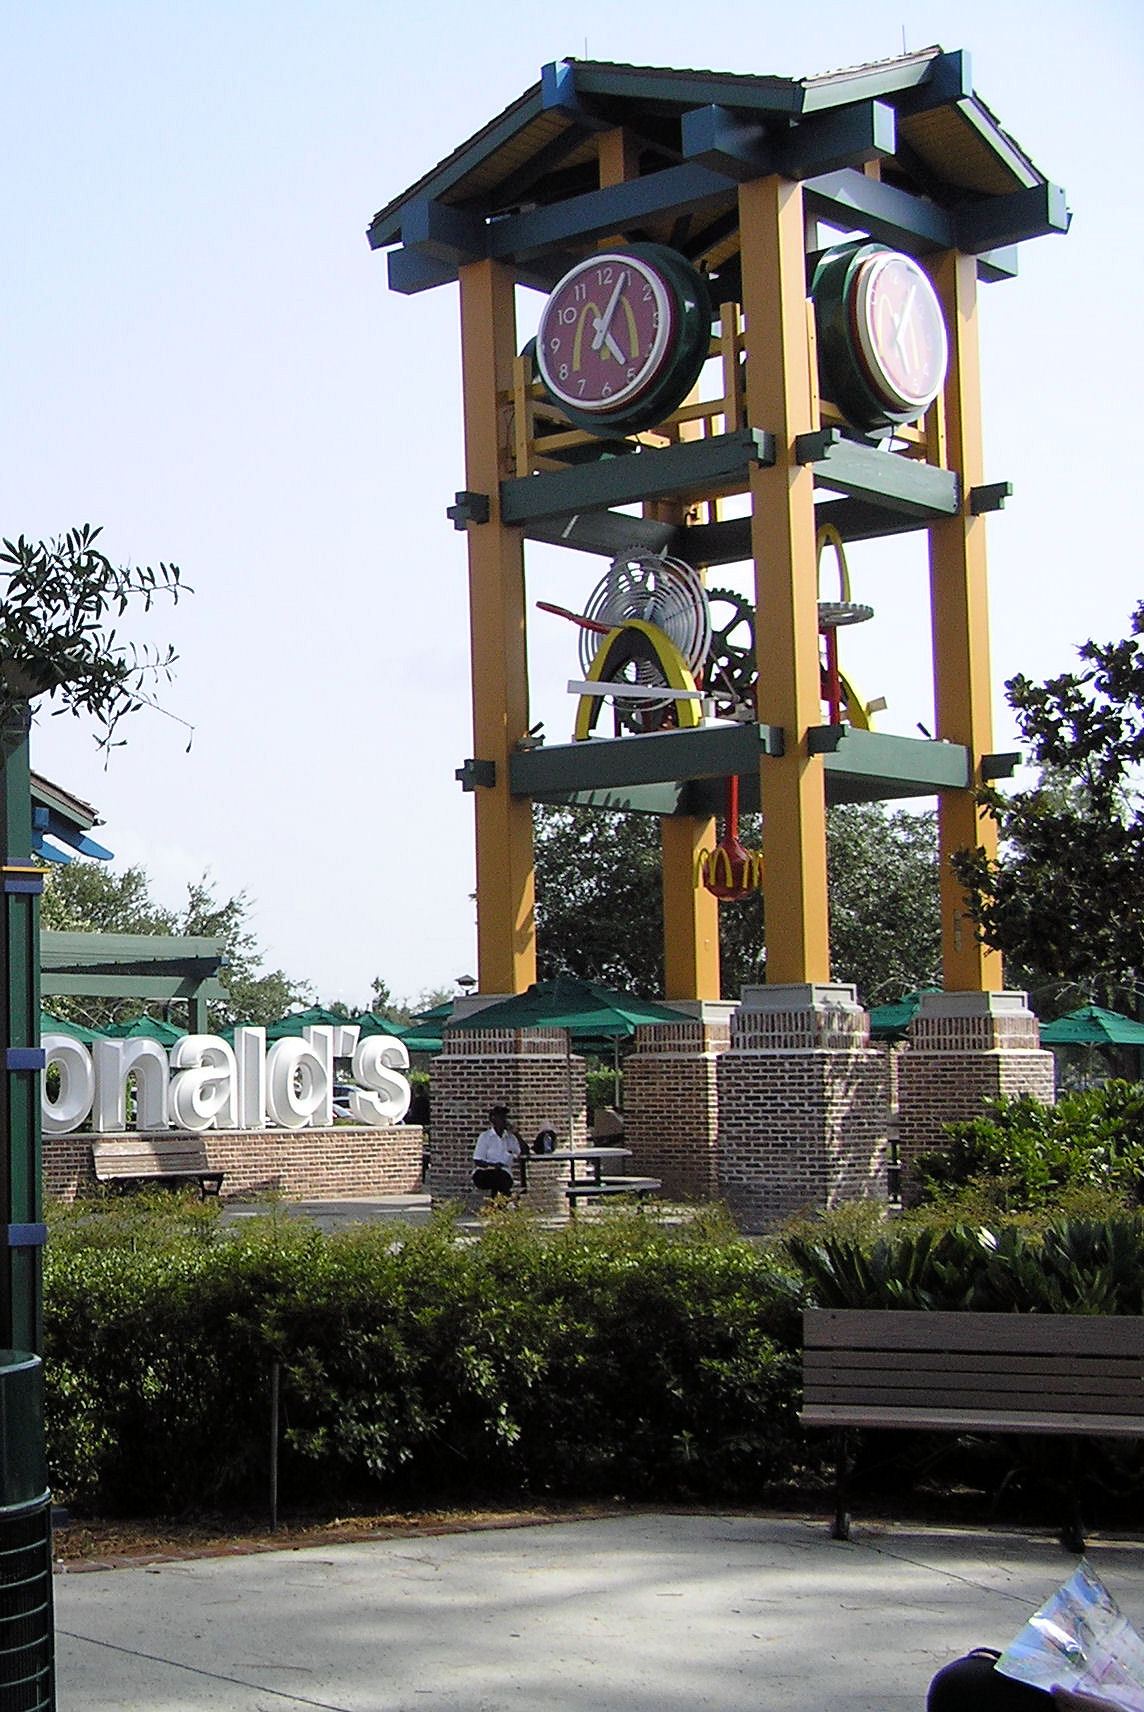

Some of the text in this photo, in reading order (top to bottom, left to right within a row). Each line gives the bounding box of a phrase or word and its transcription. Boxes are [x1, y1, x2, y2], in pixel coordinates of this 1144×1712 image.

[596, 267, 613, 285] 12
[574, 283, 587, 301] 11
[557, 306, 578, 325] 10
[550, 337, 561, 354] 9
[559, 363, 569, 381] 8
[577, 379, 587, 396] 7
